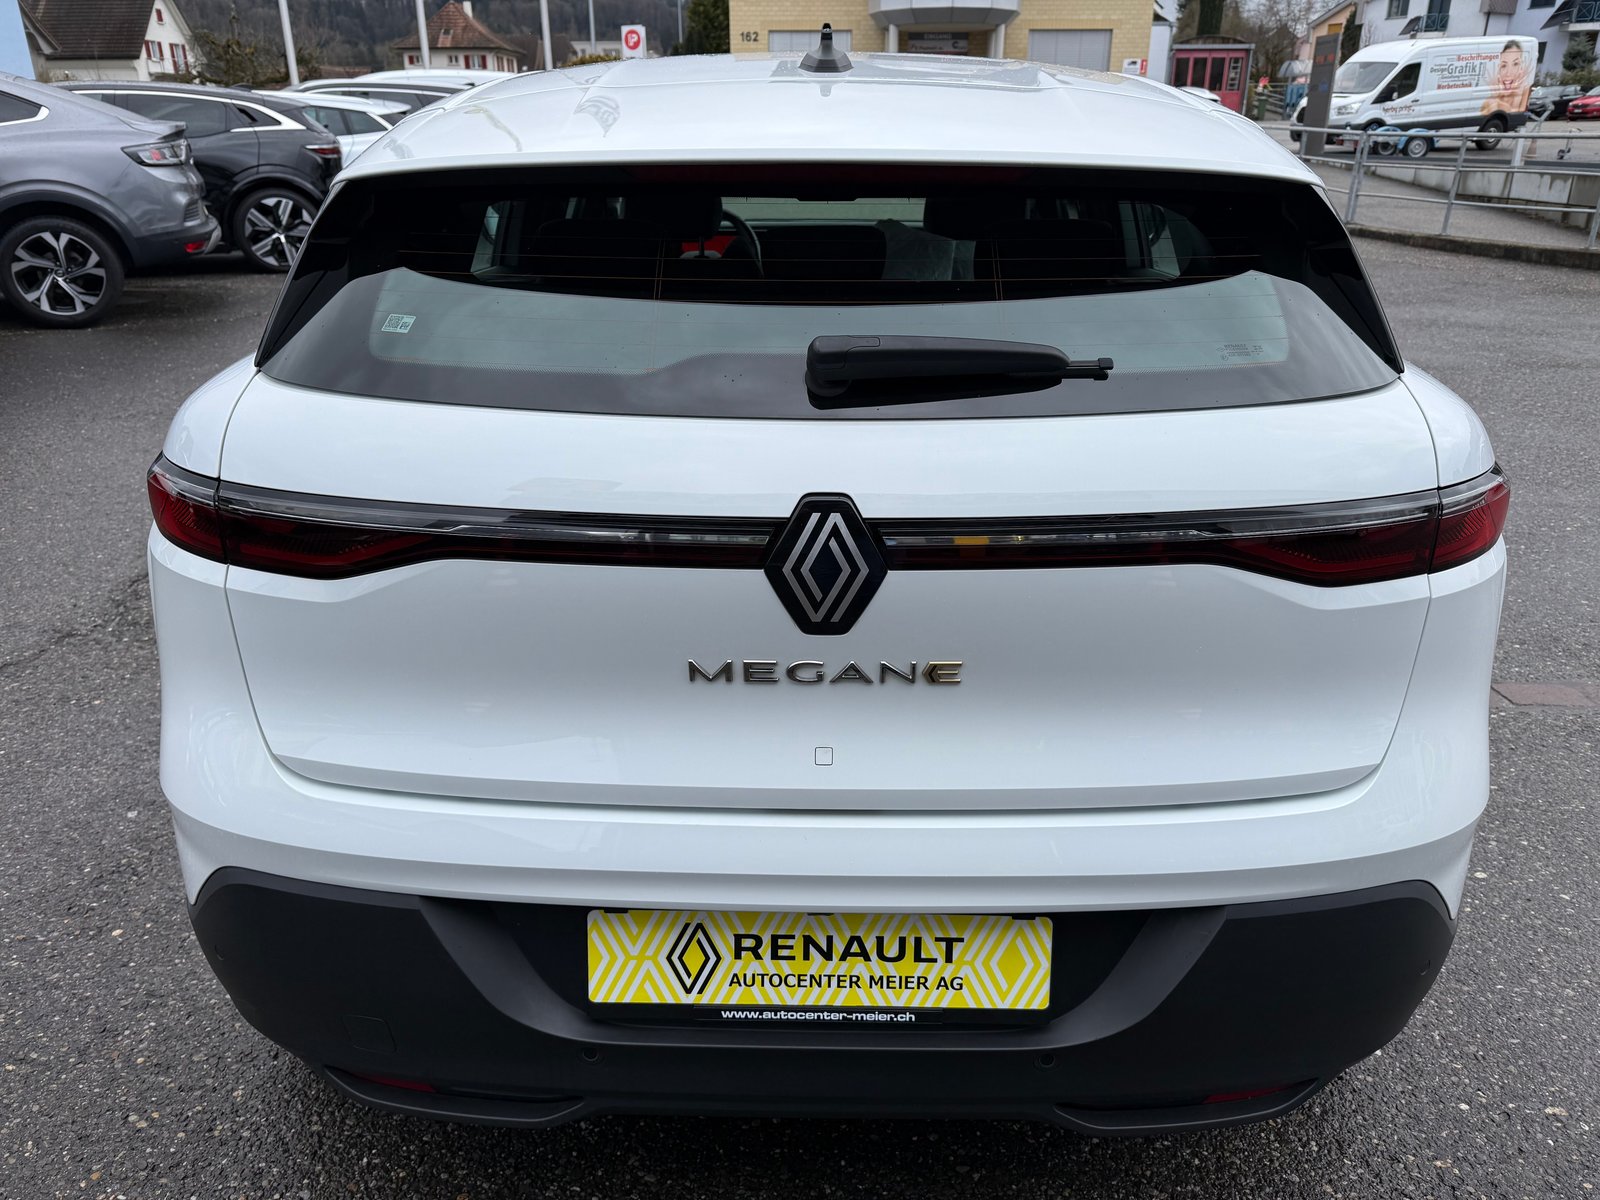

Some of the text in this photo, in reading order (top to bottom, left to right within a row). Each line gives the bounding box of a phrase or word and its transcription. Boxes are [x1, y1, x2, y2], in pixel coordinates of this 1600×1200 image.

[740, 31, 759, 42] 162
[1448, 61, 1477, 74] Grafik
[688, 659, 963, 684] MEGANE
[732, 933, 965, 964] RENAULT
[728, 973, 964, 991] AUTOCENTER MEIER AG
[721, 1009, 916, 1023] www.autocenter-meier.ch
